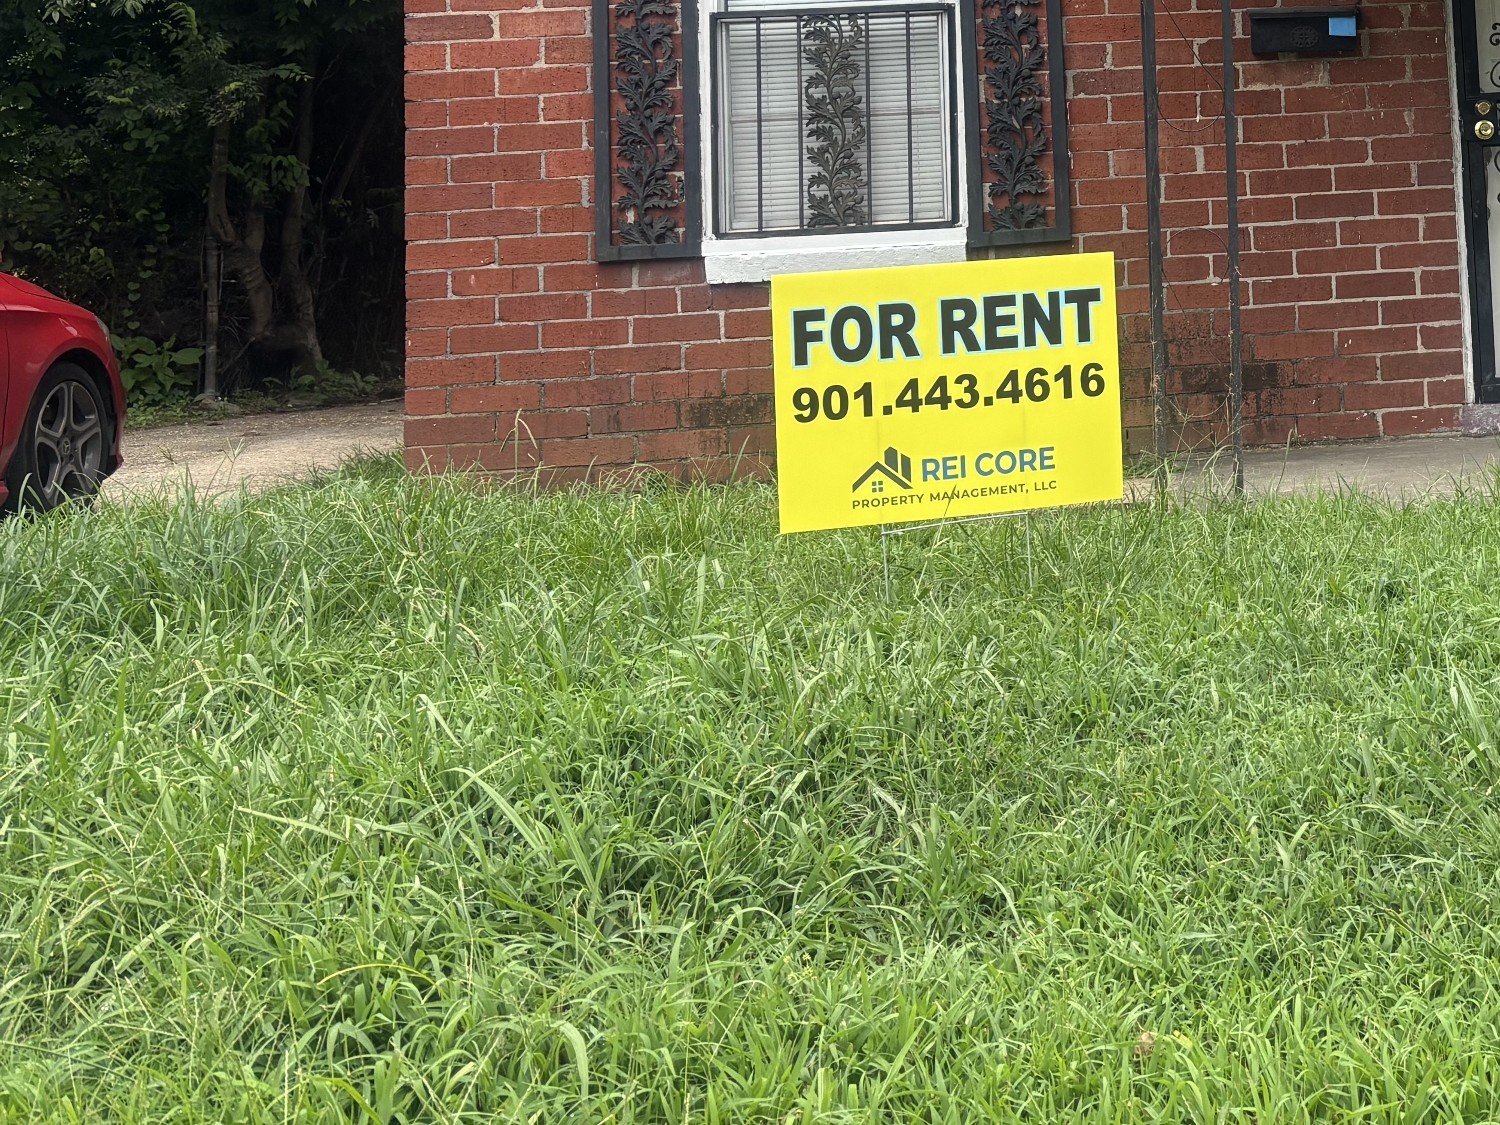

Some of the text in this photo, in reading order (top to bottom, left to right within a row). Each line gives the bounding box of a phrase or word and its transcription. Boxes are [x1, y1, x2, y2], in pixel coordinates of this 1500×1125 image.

[791, 285, 1103, 368] FOR RENT
[792, 362, 1106, 424] 901.443.4616
[922, 446, 1056, 483] REI CORE
[852, 479, 1058, 510] PROPERTY MANAGEMENT, LLC
